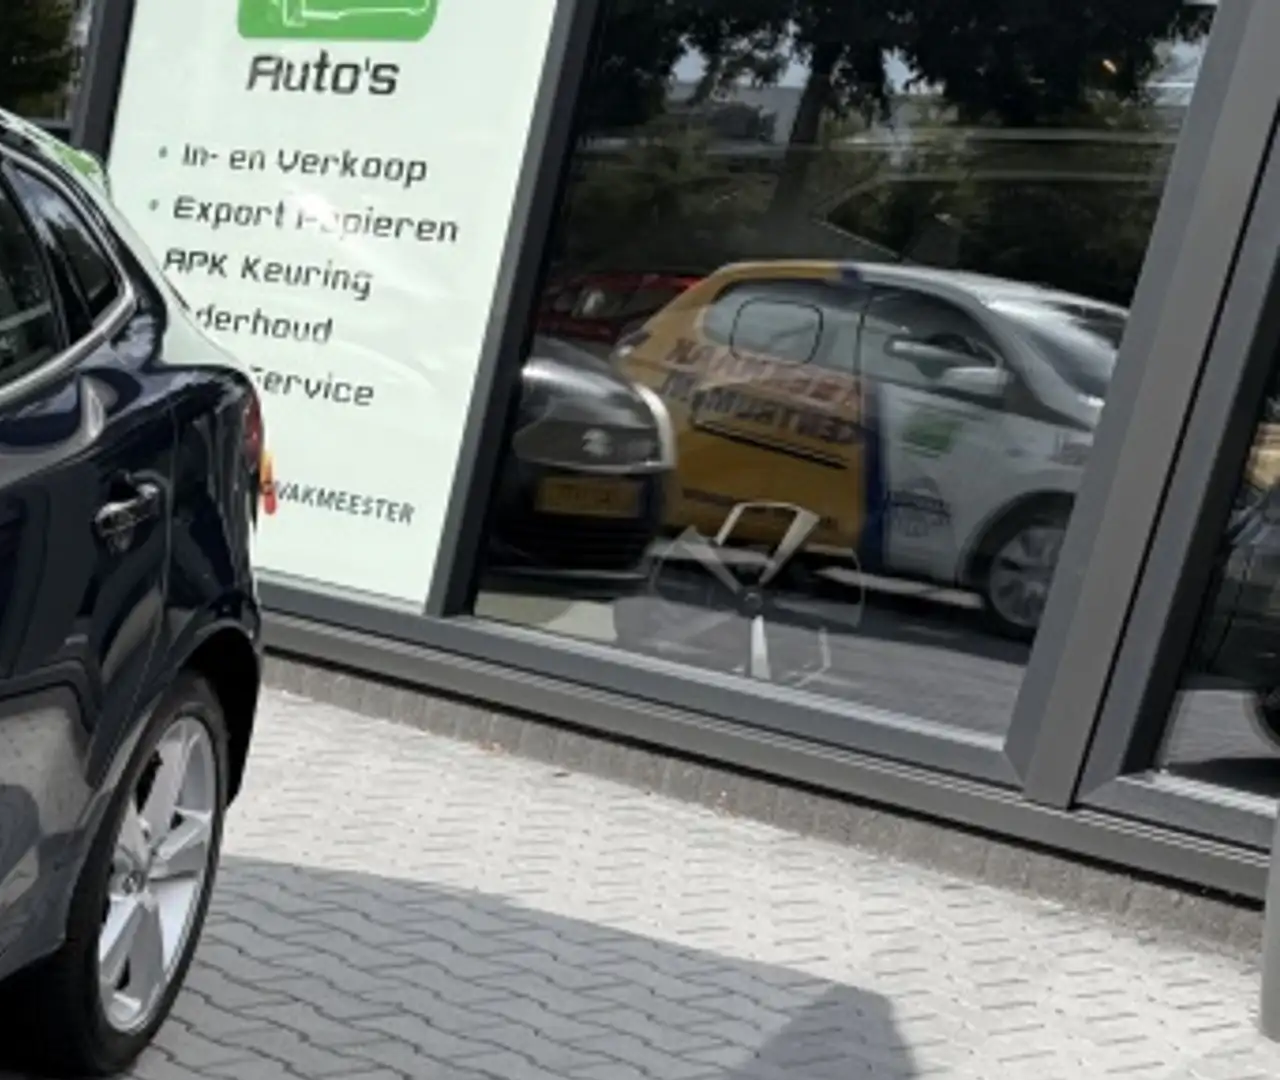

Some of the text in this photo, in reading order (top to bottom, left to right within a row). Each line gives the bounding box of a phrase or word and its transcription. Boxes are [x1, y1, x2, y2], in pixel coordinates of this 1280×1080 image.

[246, 49, 400, 95] Auto's
[229, 149, 266, 171] en
[277, 149, 428, 189] Verkoop
[173, 195, 285, 230] Export
[163, 248, 374, 301] APK Keuring
[196, 303, 333, 343] derhoud
